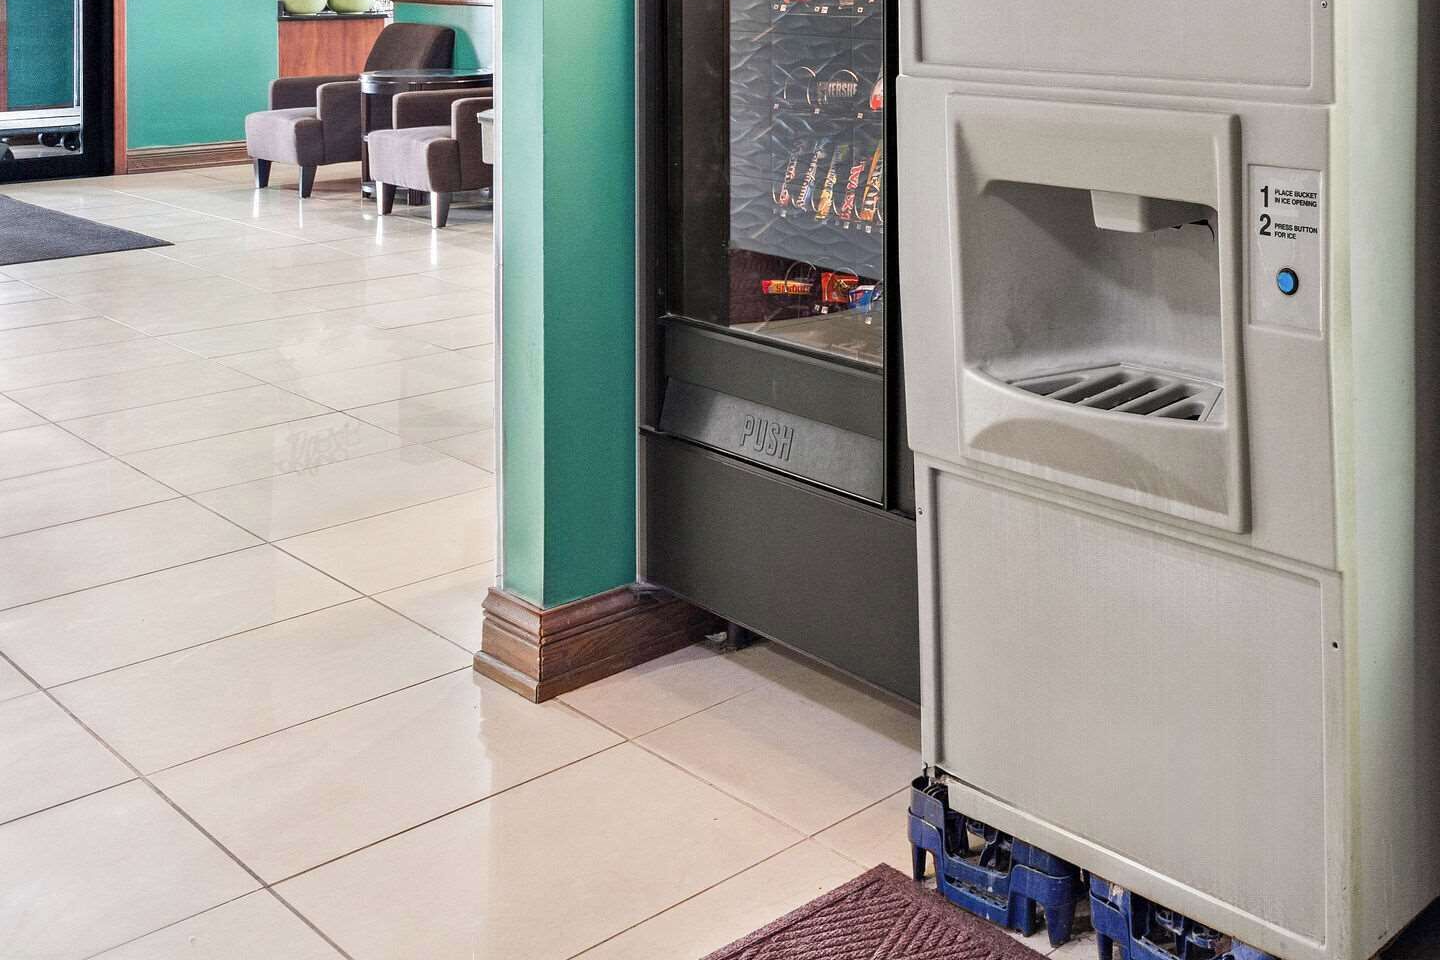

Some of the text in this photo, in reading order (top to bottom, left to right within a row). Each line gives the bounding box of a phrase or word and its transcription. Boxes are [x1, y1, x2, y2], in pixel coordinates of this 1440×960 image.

[1260, 185, 1318, 208] 1 PLACE BUCKET
[1291, 199, 1318, 208] OPENING
[1260, 213, 1318, 237] 2 PRESS BUTTON
[1275, 231, 1286, 239] FOR
[739, 414, 794, 462] PUSH
